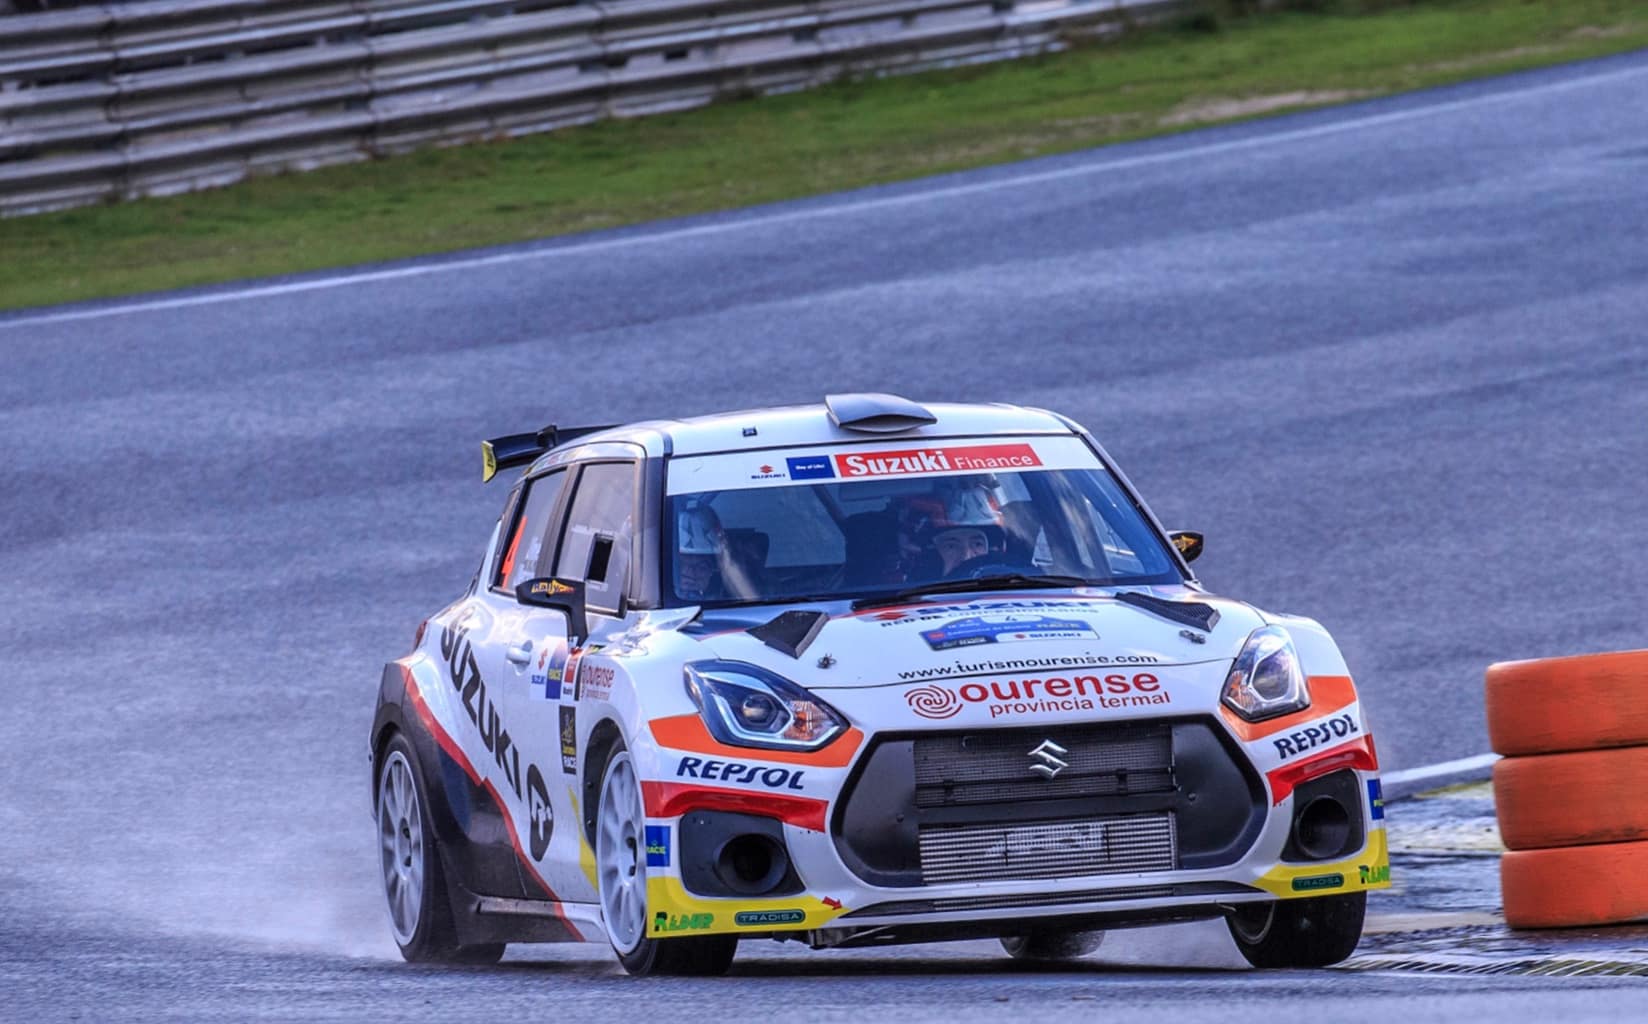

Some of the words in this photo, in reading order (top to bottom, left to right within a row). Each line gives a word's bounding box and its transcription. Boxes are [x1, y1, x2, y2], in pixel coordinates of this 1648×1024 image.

[846, 451, 951, 475] Suzuki
[954, 454, 1033, 471] Finance
[916, 601, 1092, 615] SUZUKI
[898, 656, 1158, 681] www.turismourense.com
[959, 672, 1161, 704] ourense
[440, 607, 522, 802] SUZUKI
[989, 696, 1094, 718] provincia
[1100, 691, 1171, 710] termal
[1272, 714, 1359, 760] REPSOL
[676, 756, 805, 790] REPSOL
[739, 912, 801, 923] TRADISA
